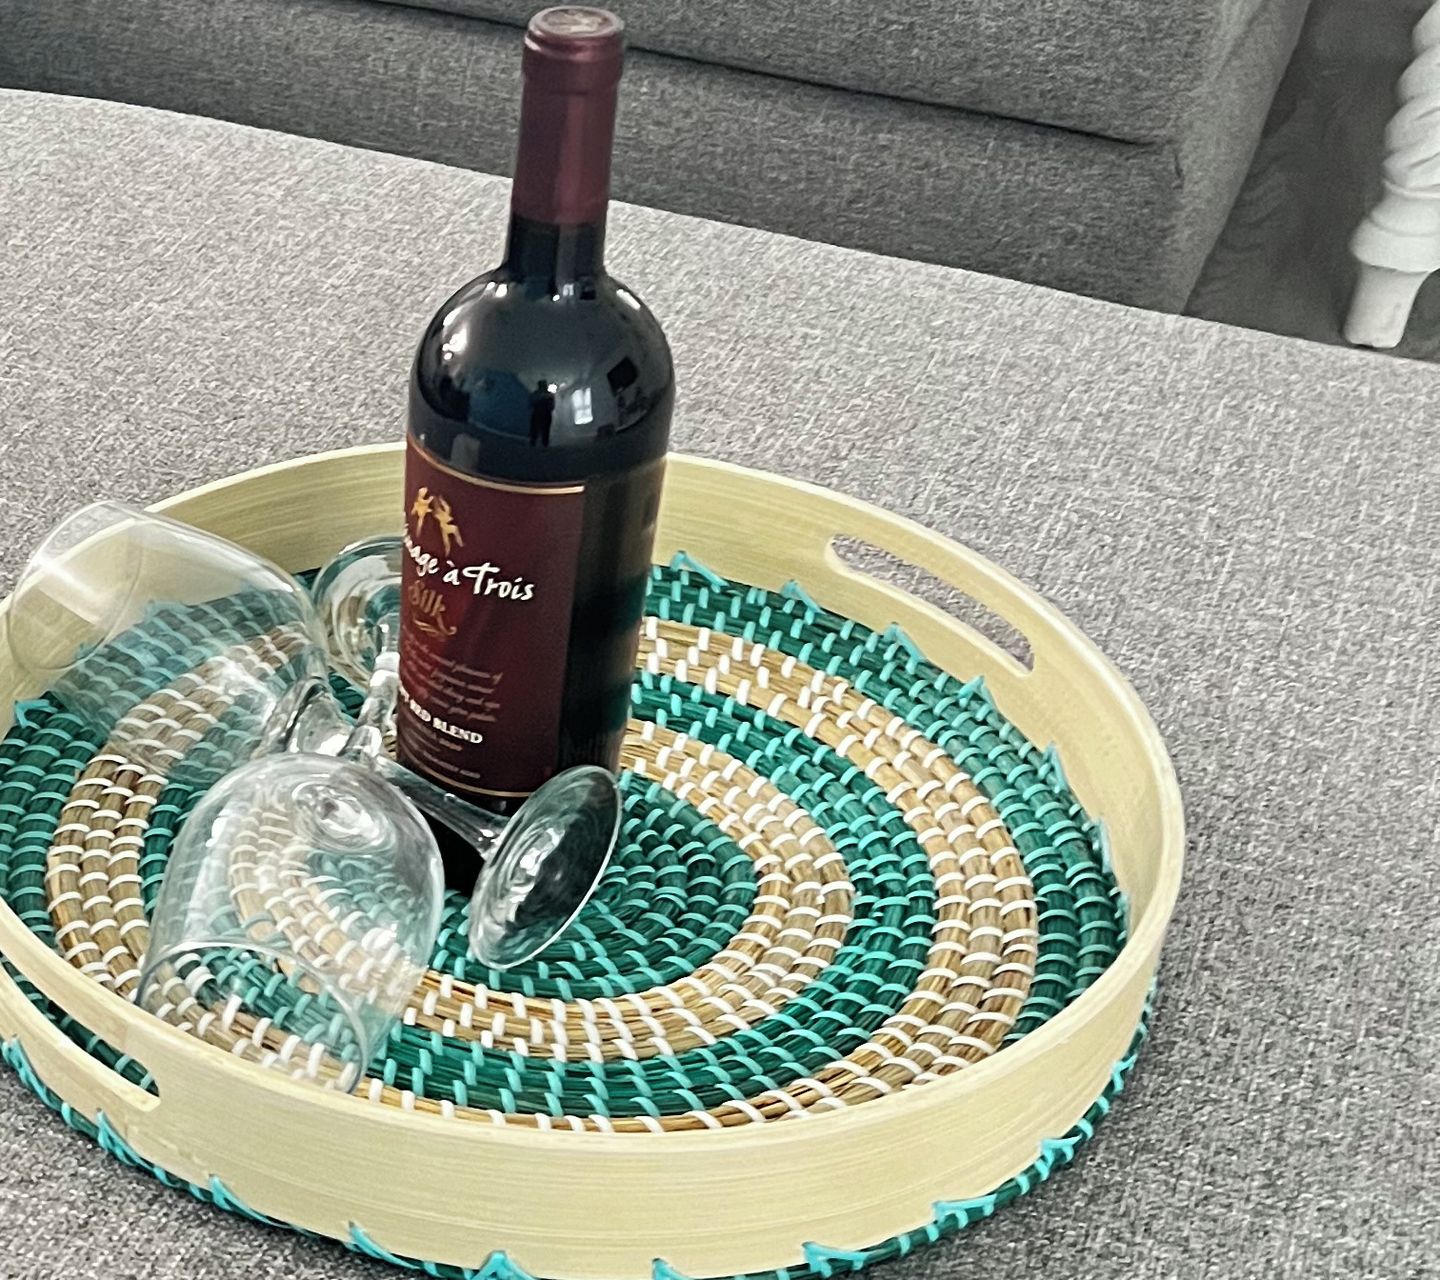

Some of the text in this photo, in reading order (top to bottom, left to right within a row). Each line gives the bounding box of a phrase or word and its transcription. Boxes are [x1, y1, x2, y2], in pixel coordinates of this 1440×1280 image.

[442, 560, 461, 586] à
[462, 561, 536, 601] Trois
[410, 698, 432, 722] RED
[433, 717, 484, 744] BLEND
